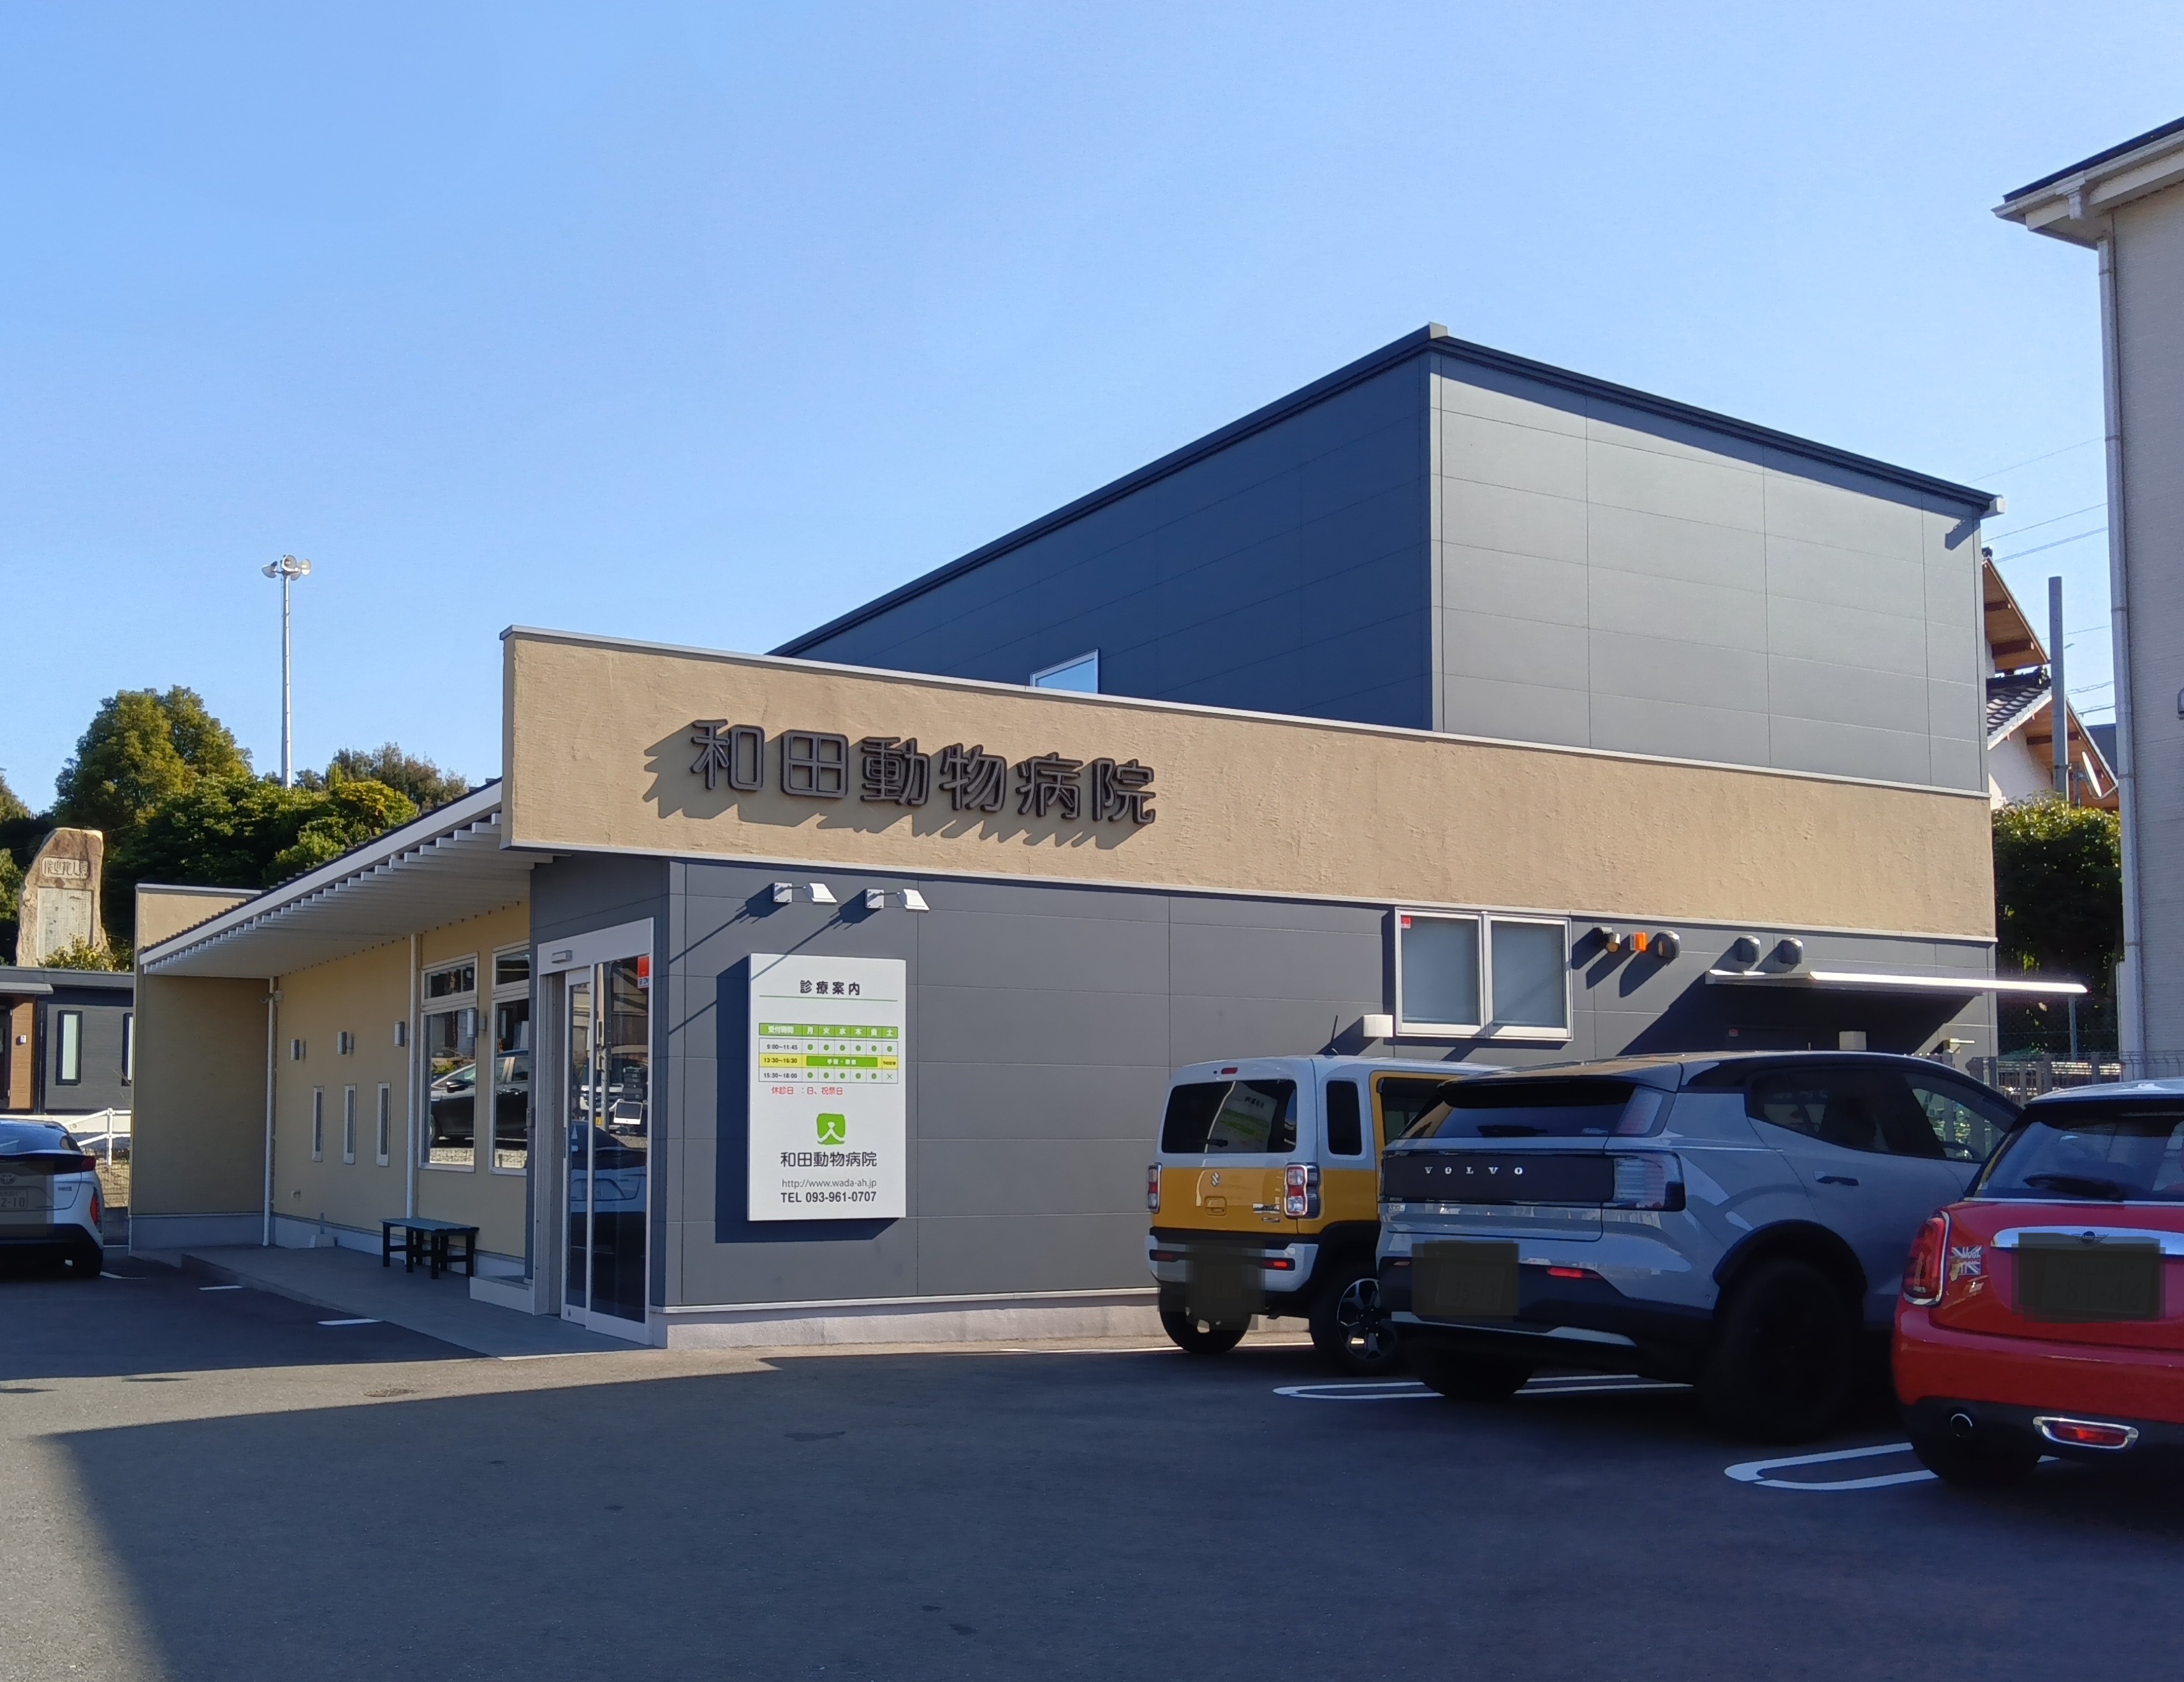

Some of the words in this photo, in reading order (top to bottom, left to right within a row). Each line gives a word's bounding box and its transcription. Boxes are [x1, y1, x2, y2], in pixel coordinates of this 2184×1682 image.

[691, 719, 1156, 824] 和田動物病院
[800, 979, 860, 996] 診療案内
[807, 1026, 814, 1035] 月
[823, 1027, 830, 1035] 火
[839, 1027, 847, 1035] 水
[886, 1028, 893, 1037] 土
[780, 1152, 877, 1167] 和田動物病院
[1424, 1166, 1523, 1175] VOLVO
[782, 1178, 877, 1189] http://www.wada-ah.jp
[780, 1192, 802, 1203] TEL
[805, 1191, 877, 1203] 093-961-0707
